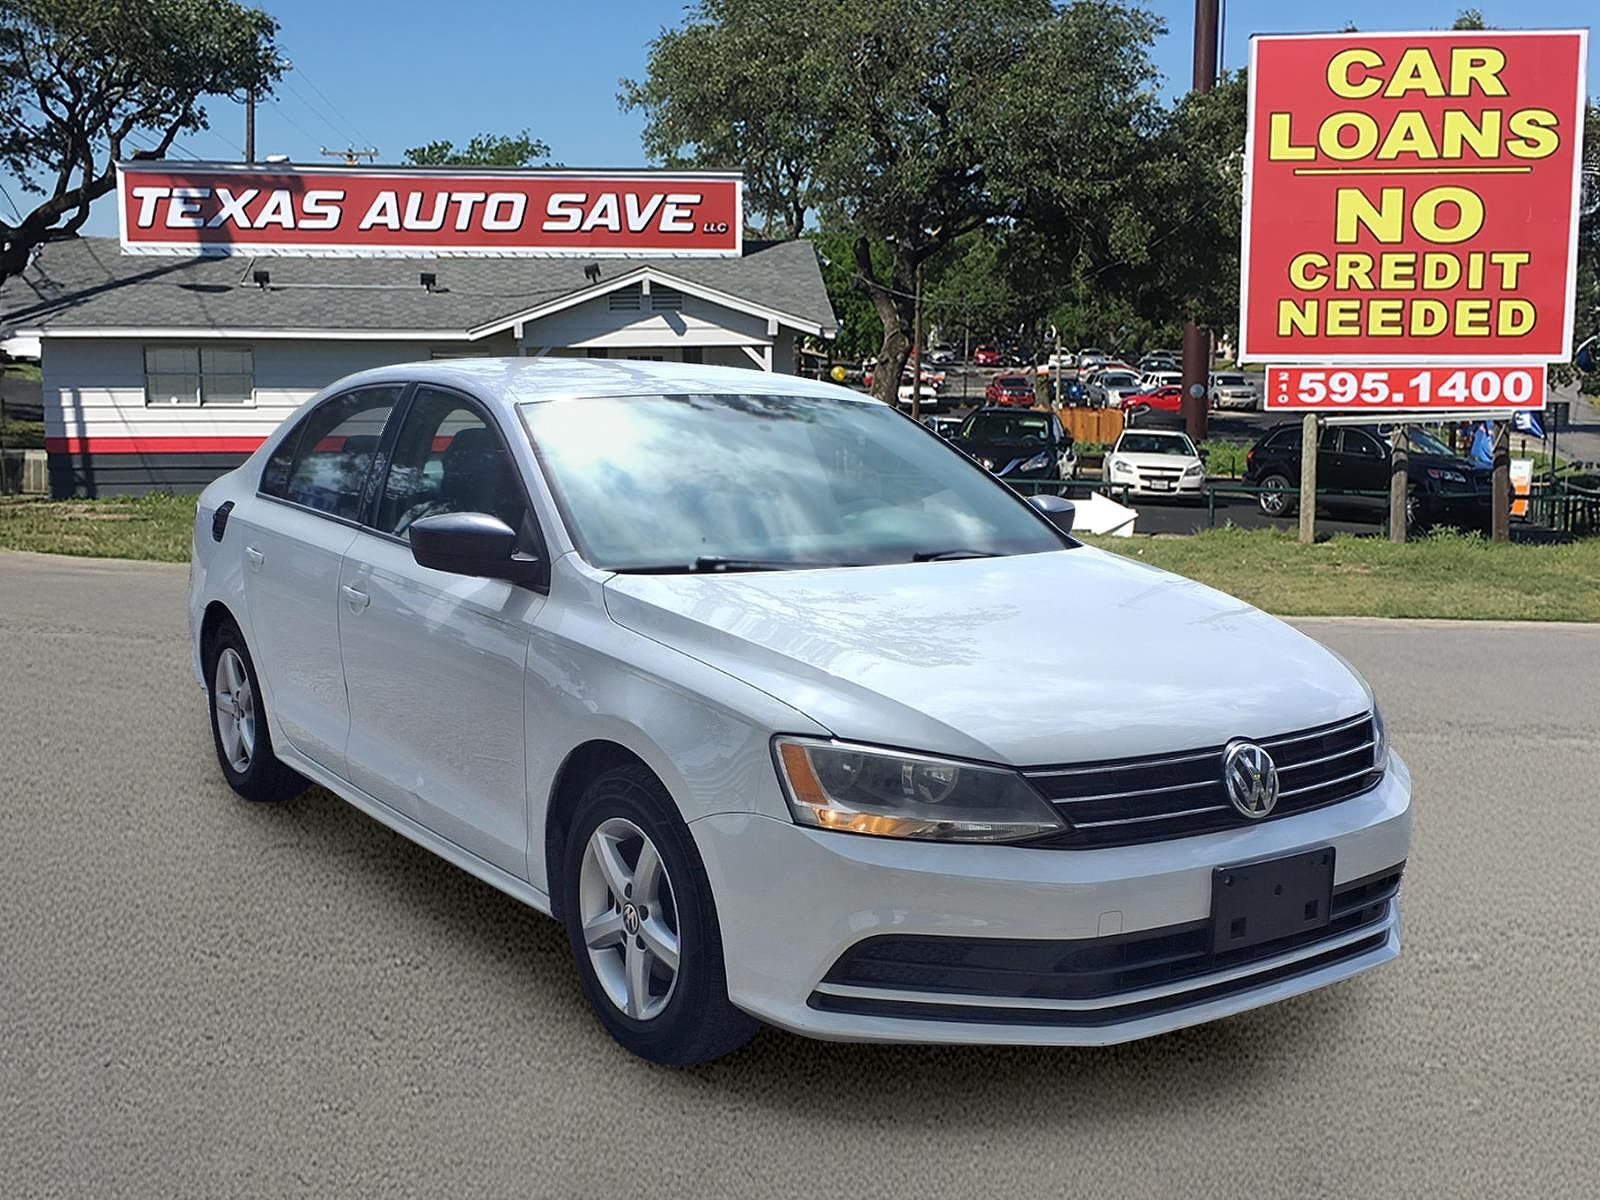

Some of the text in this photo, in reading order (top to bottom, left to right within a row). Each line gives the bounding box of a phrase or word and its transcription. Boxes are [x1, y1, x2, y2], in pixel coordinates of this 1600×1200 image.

[1326, 47, 1508, 98] CAR
[1269, 109, 1560, 161] LOANS
[132, 187, 728, 234] TEXAS AUTO SAVE LLC
[1335, 186, 1484, 244] NO
[1289, 252, 1530, 291] CREDIT
[1277, 299, 1537, 338] NEEDED
[1297, 371, 1533, 404] 595.1400
[1227, 744, 1277, 818] VW
